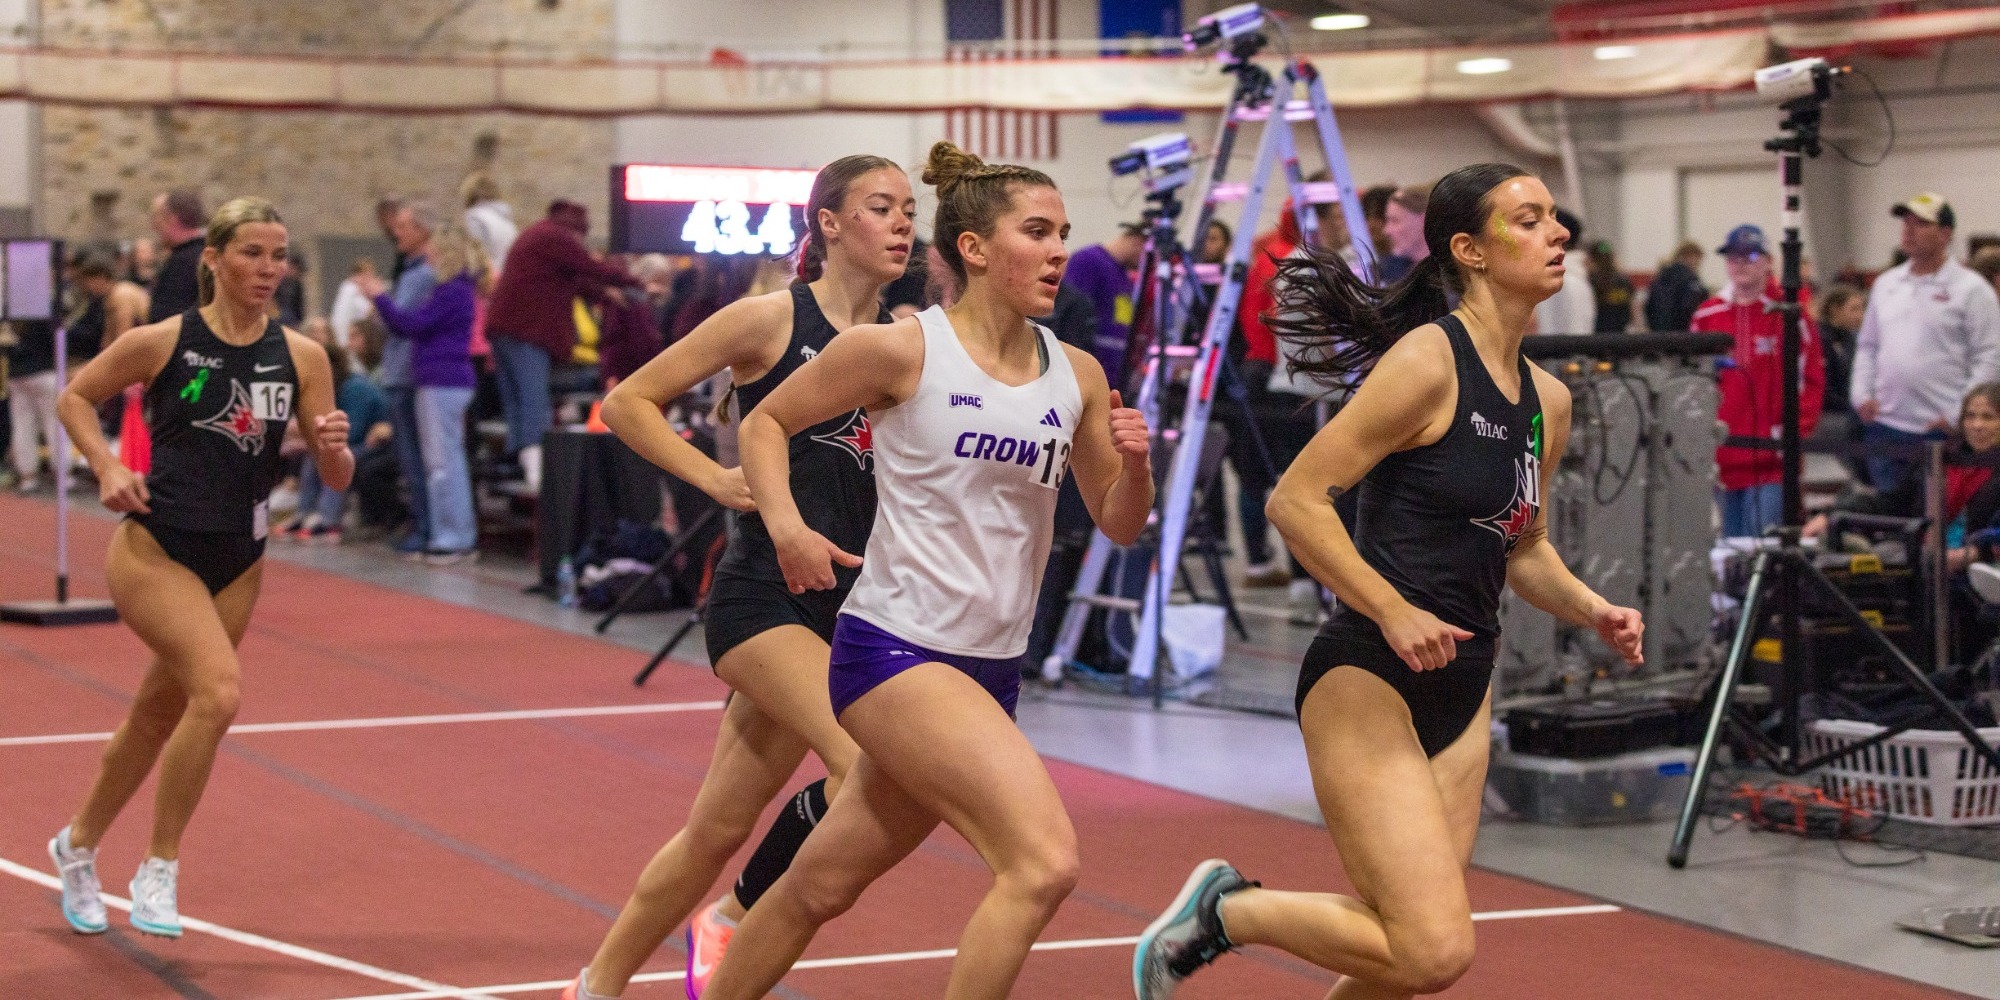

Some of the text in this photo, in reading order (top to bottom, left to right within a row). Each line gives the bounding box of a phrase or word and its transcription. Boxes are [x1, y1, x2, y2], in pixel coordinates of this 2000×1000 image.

[681, 200, 796, 255] 43.4
[260, 386, 286, 419] 16
[950, 394, 982, 408] UMAC
[953, 431, 1040, 468] CROW
[1474, 421, 1508, 441] WIAC
[1039, 438, 1071, 489] 13
[1526, 456, 1541, 503] 1
